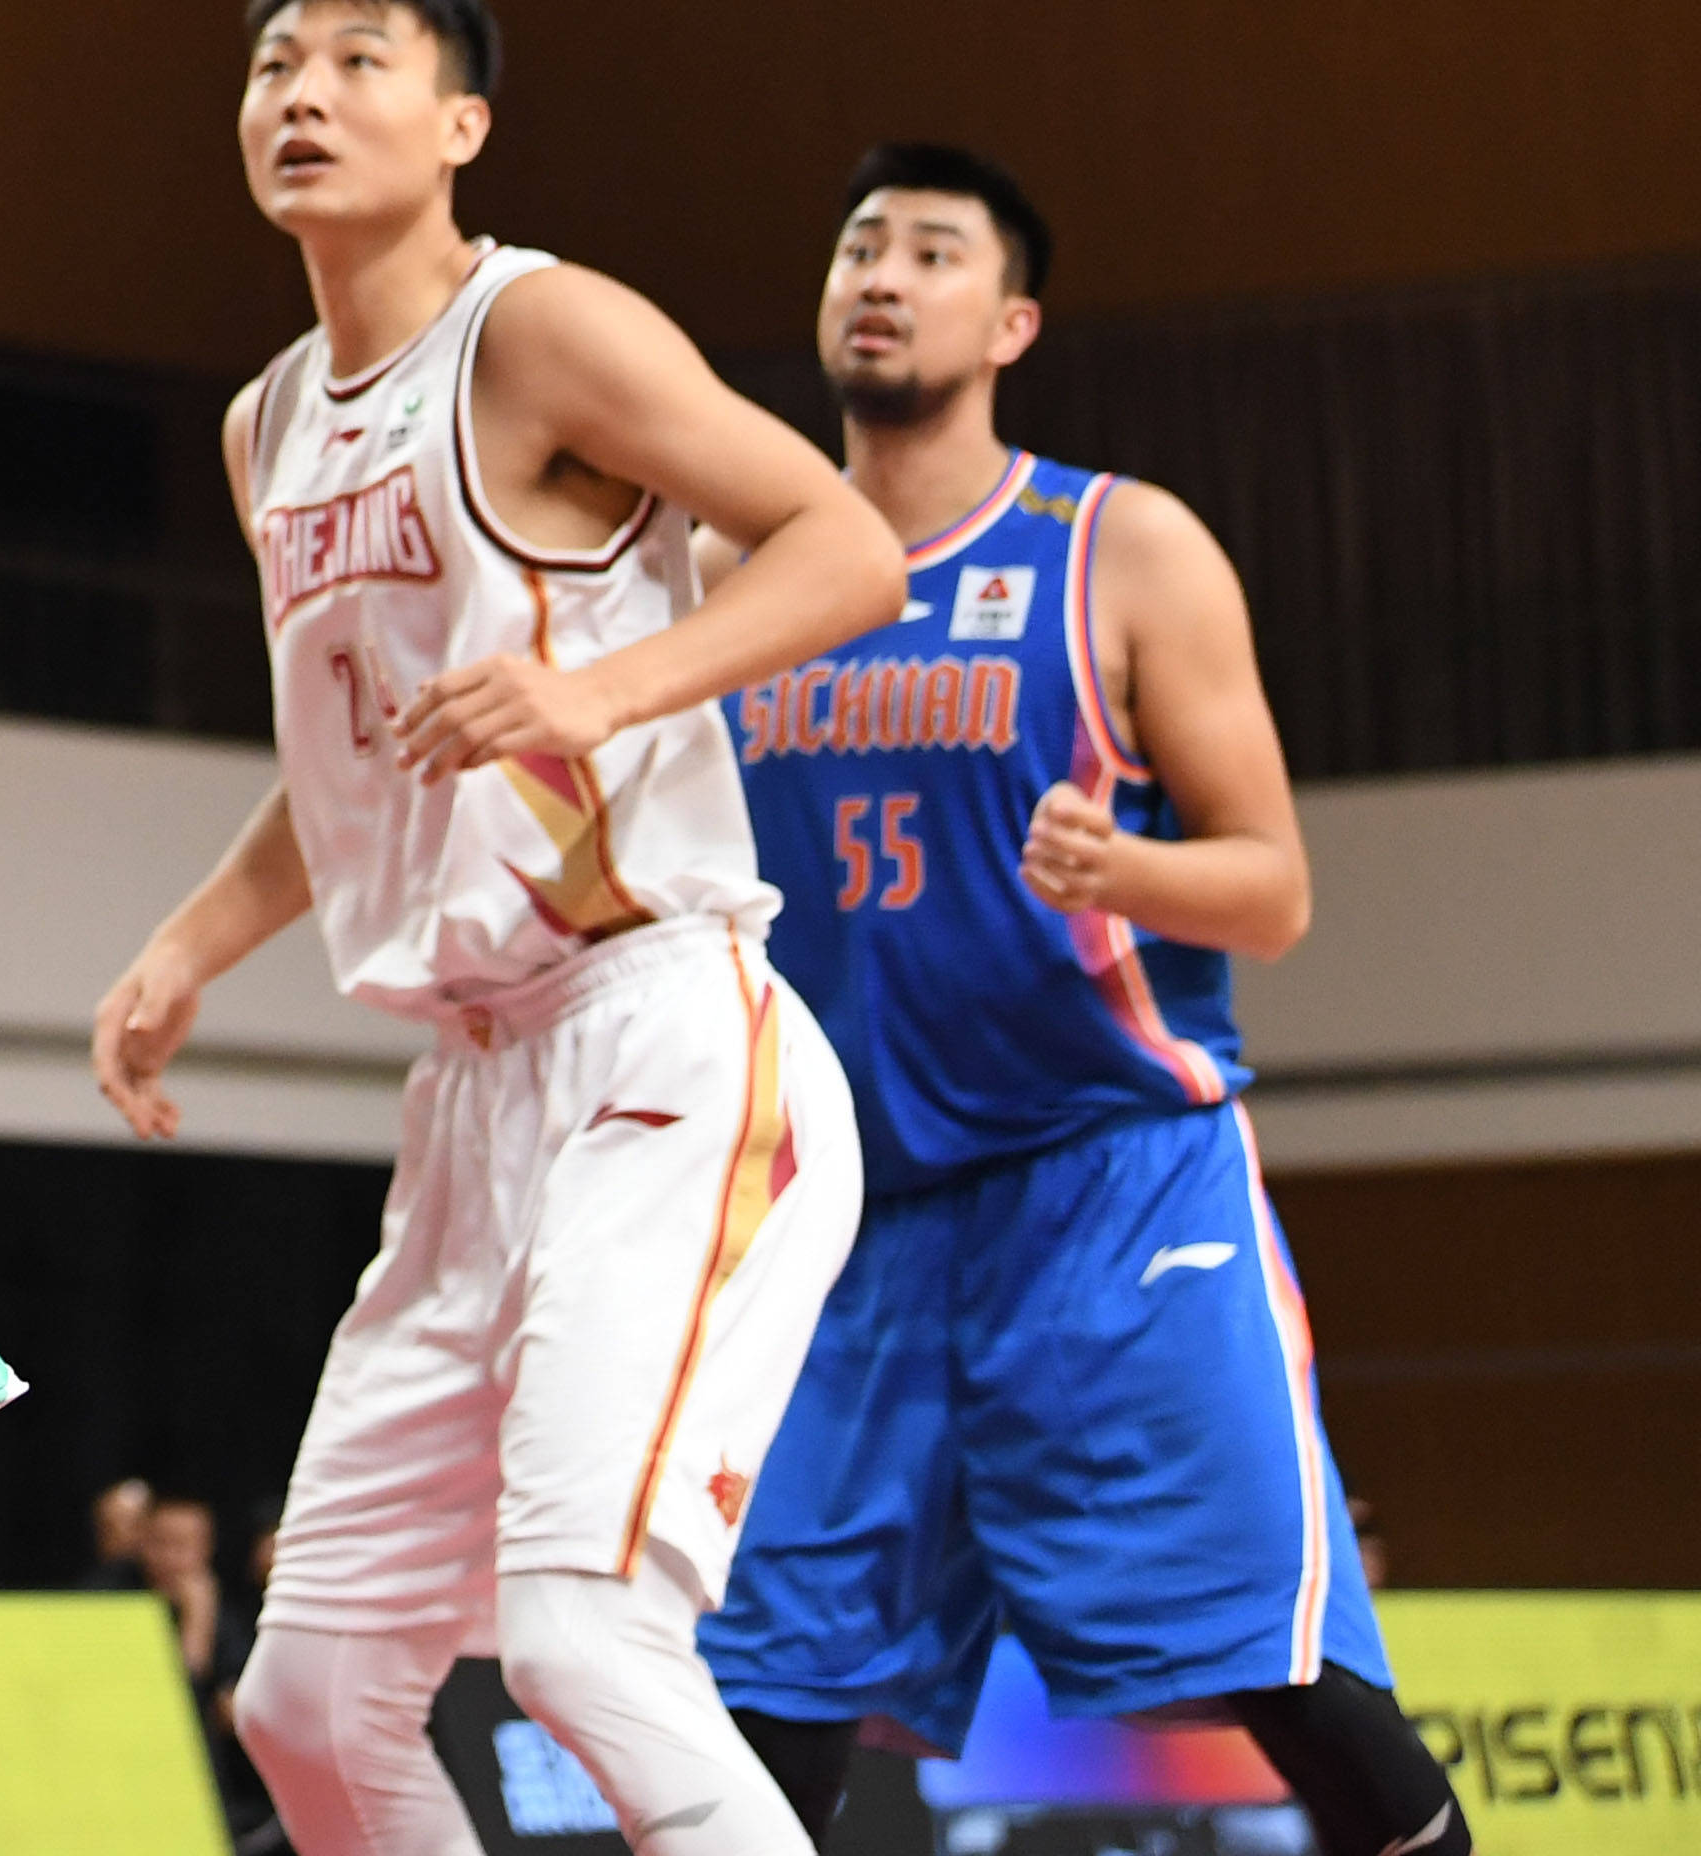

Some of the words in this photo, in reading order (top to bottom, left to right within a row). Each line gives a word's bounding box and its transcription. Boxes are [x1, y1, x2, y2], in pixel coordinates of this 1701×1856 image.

[739, 654, 1021, 765] SICHUAN
[833, 793, 927, 911] 55
[1407, 1707, 1685, 1803] PISEN
